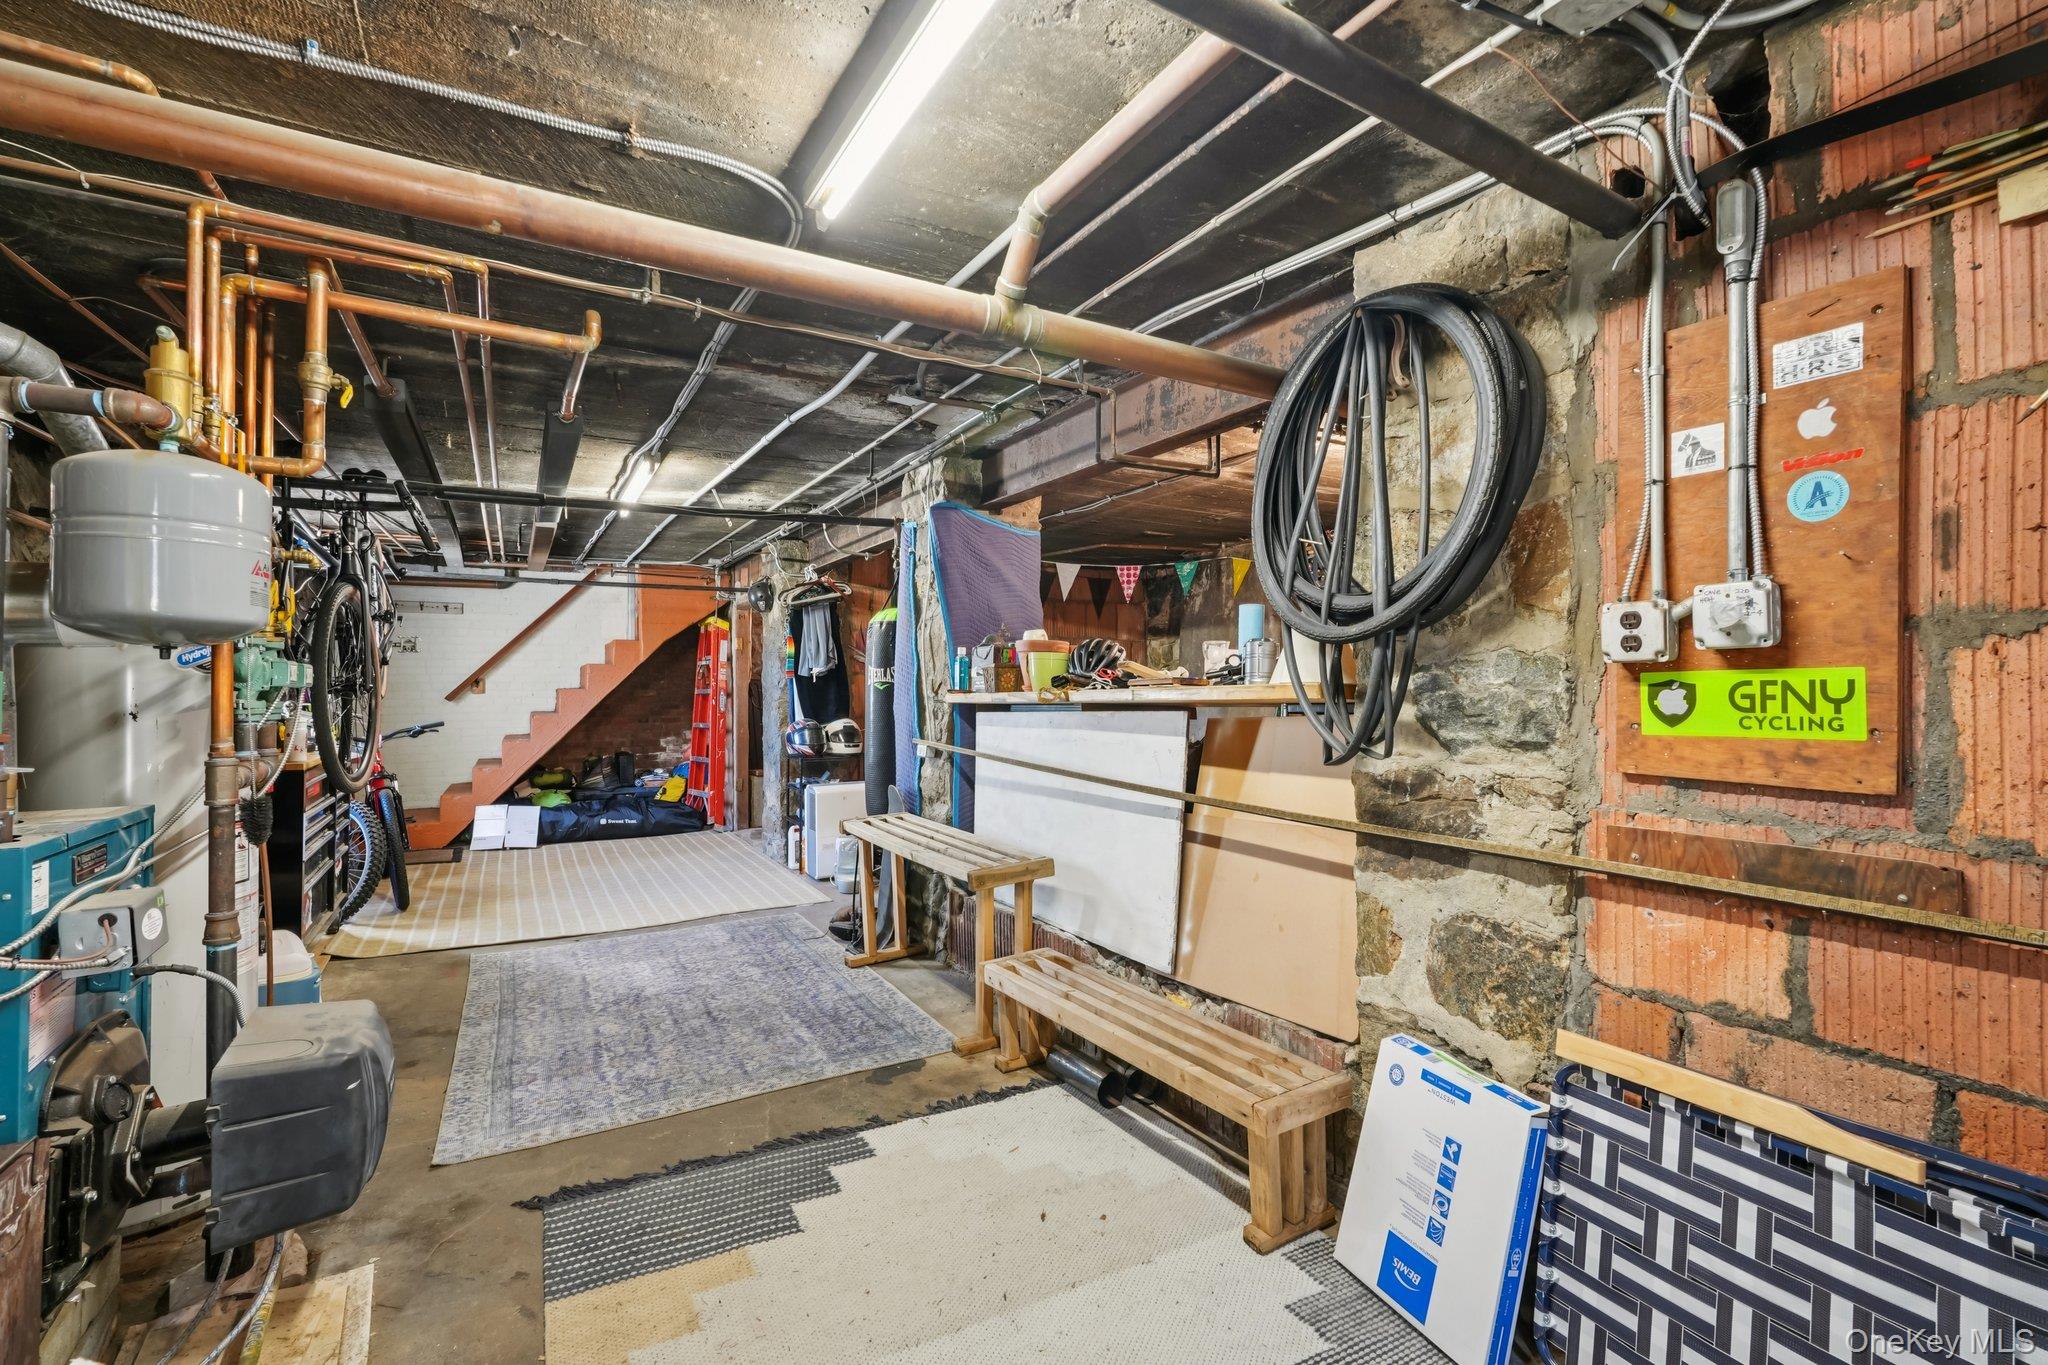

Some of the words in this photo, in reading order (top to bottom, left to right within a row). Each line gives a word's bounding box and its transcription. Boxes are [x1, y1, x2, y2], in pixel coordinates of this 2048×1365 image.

[1728, 678, 1856, 715] GFNY
[1738, 715, 1845, 733] CYCLING
[1392, 1257, 1422, 1286] BEMIS
